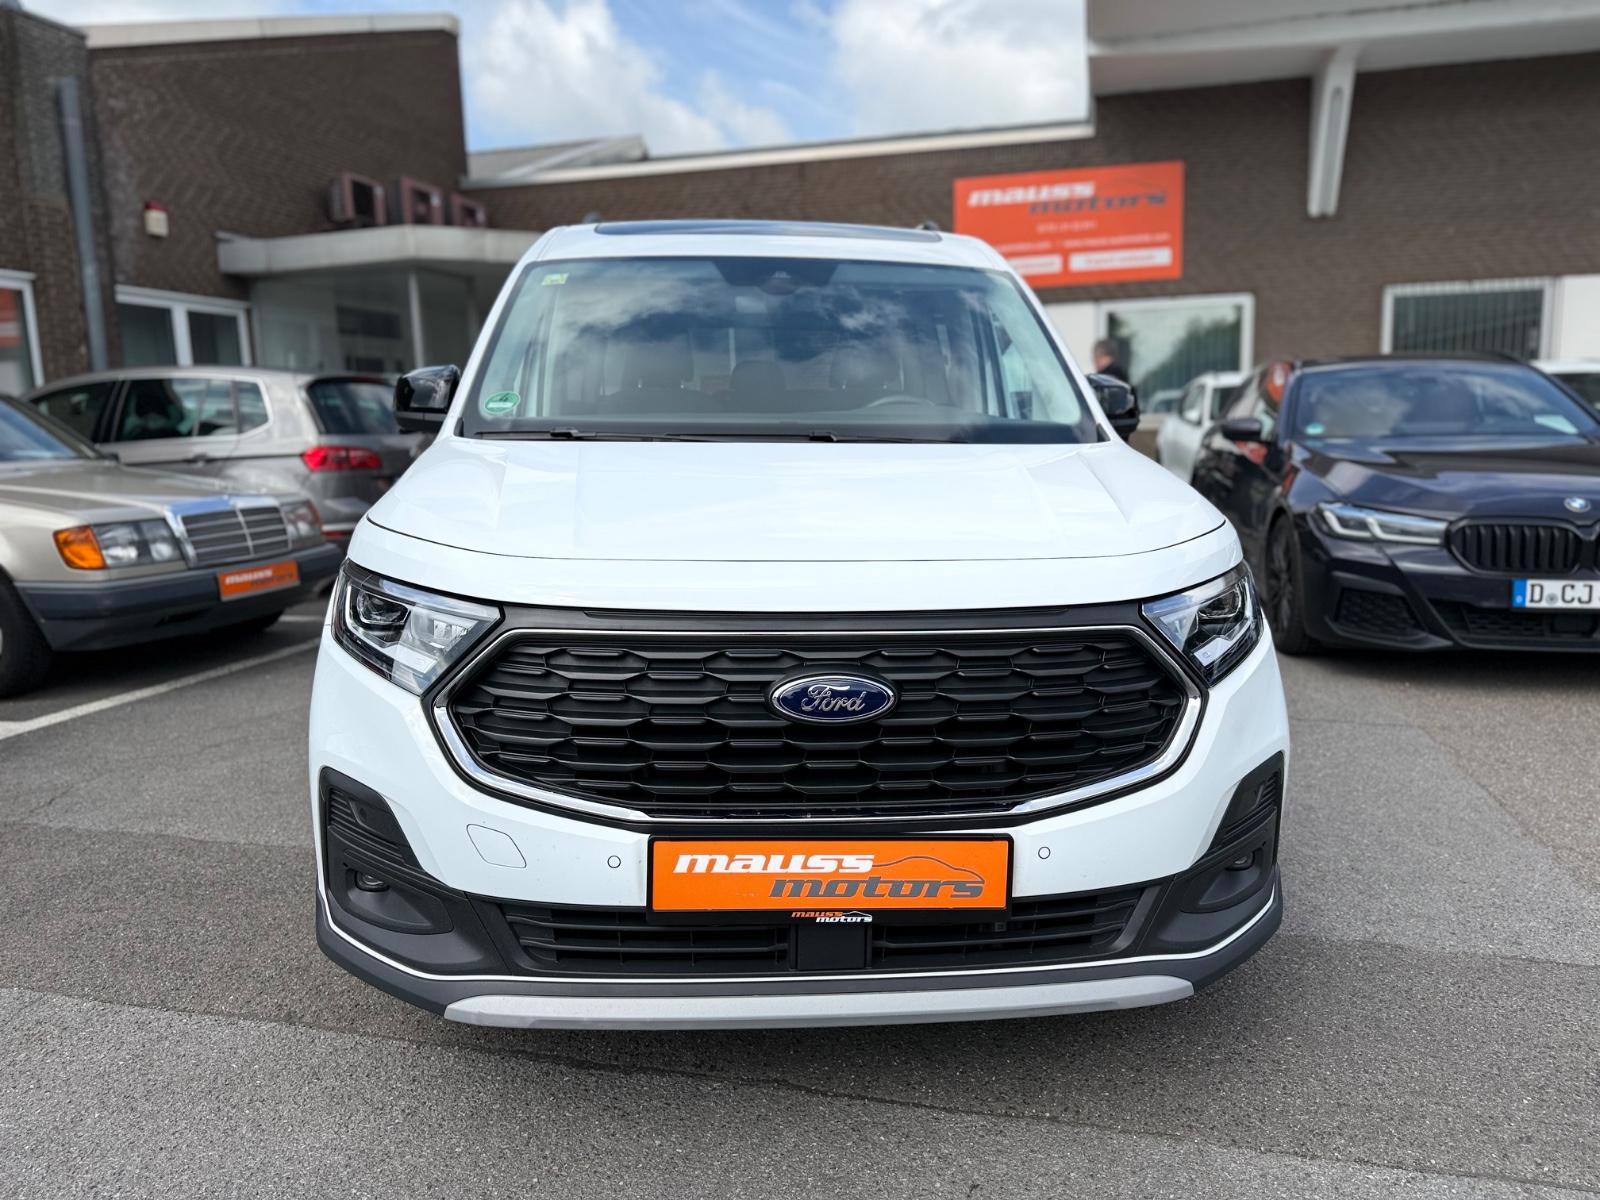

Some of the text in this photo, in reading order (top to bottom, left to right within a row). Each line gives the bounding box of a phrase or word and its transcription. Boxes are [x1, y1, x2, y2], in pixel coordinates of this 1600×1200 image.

[967, 181, 1095, 207] mauss
[1529, 583, 1594, 604] D CJ
[800, 684, 867, 711] Ford
[672, 854, 875, 874] mauss
[768, 876, 985, 898] motors
[816, 915, 872, 923] motors
